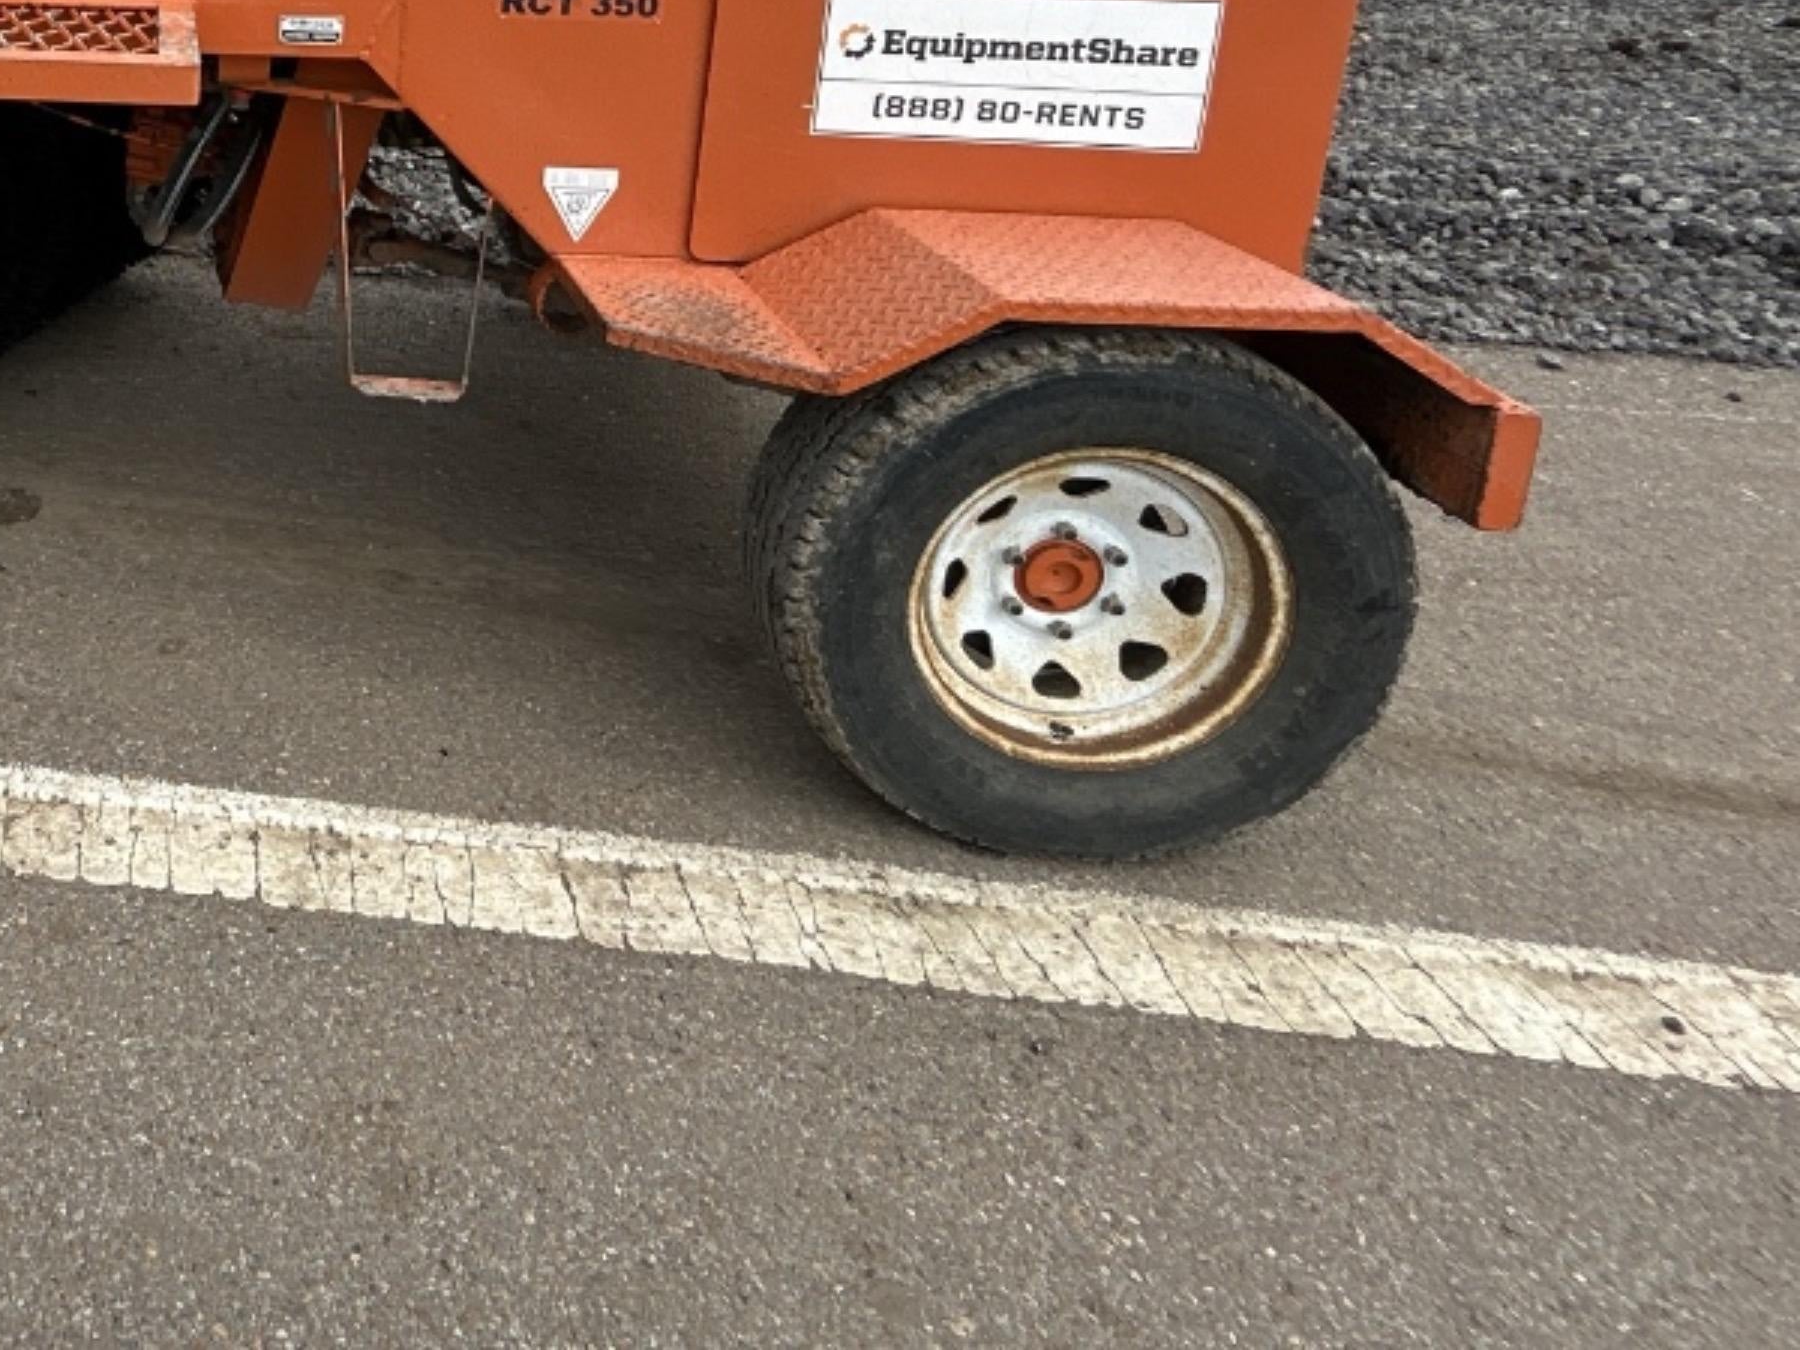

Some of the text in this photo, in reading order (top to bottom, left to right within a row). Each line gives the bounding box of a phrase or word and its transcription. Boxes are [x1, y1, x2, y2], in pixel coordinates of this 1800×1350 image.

[880, 28, 1199, 68] EquipmentShare
[871, 92, 1146, 130] (888) 80-RENTS
